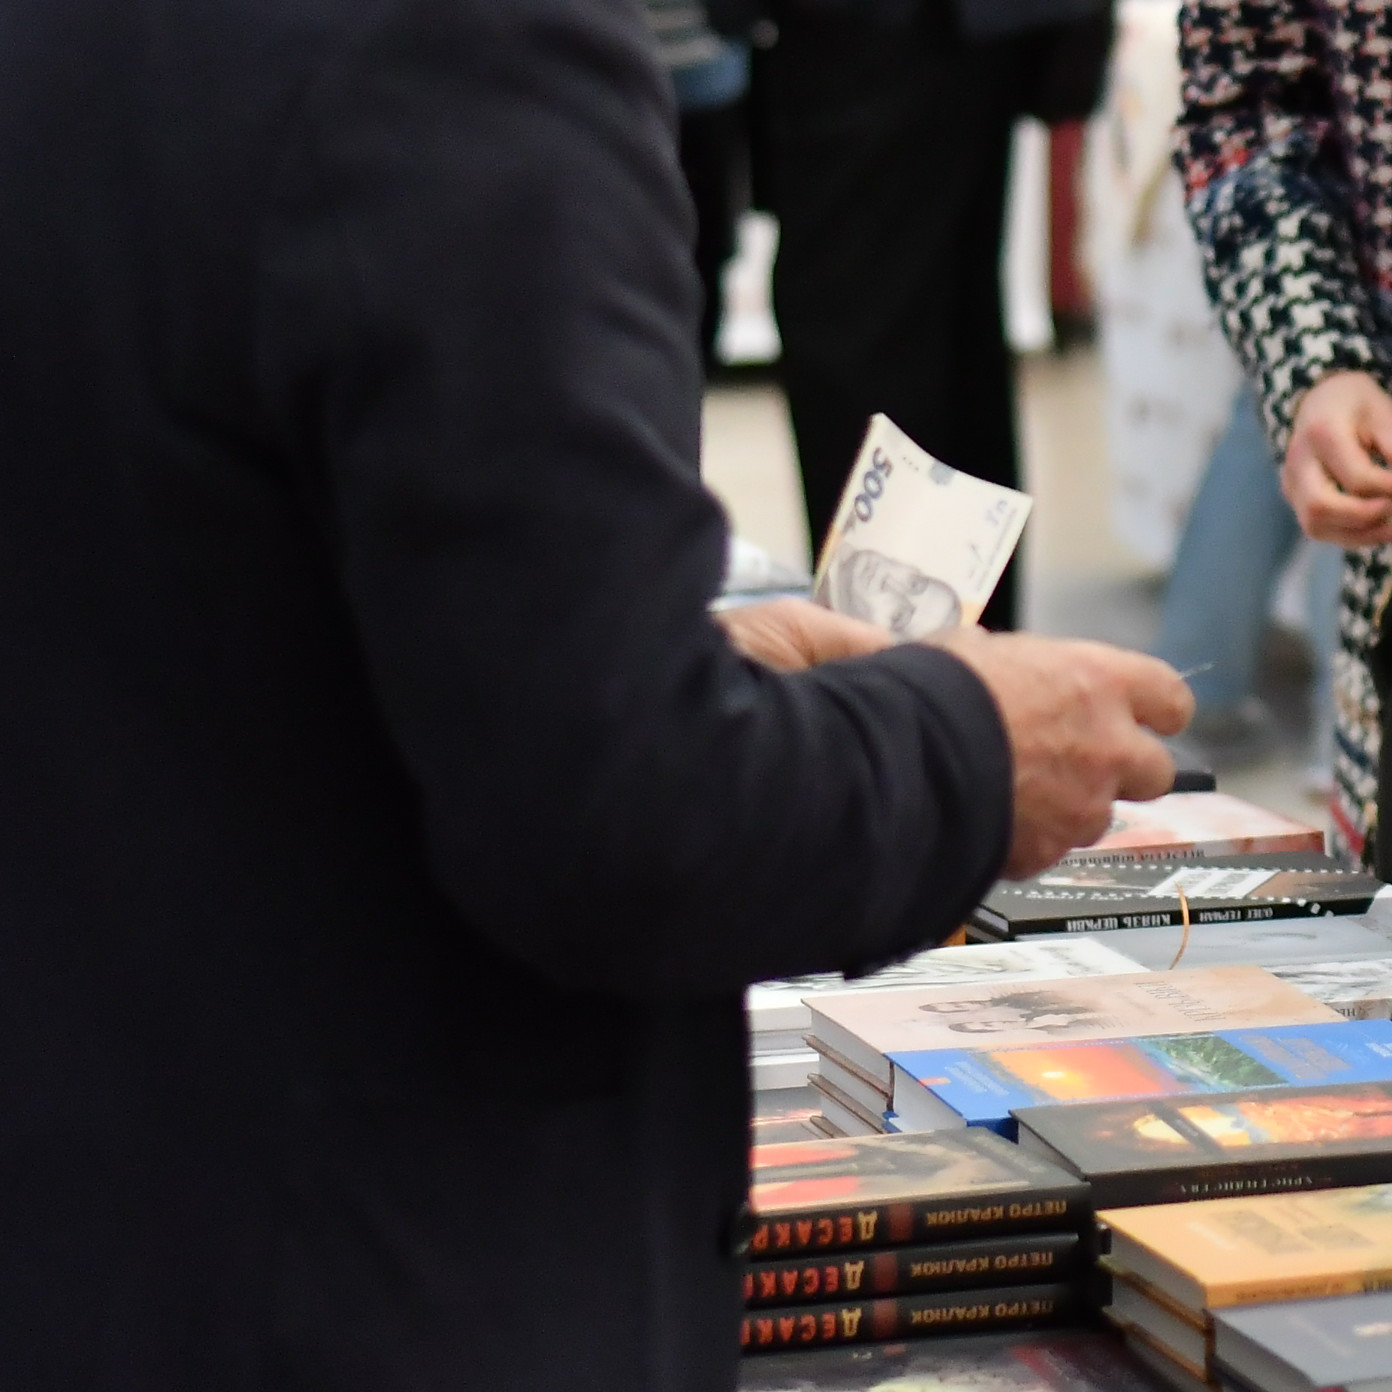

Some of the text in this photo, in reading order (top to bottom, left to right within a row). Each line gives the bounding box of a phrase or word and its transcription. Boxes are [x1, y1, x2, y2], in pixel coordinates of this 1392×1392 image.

[854, 447, 893, 522] 500
[1066, 912, 1171, 933] КНЯЗЬ ЦЕРКВИ
[1199, 909, 1242, 923] ГЕРМАН
[926, 1205, 1004, 1226] КРАЛЮК
[1010, 1199, 1067, 1219] ПЕТРО
[910, 1256, 990, 1278] КРАЛЮК
[994, 1251, 1054, 1271] ПЕТРО
[911, 1305, 990, 1325] КРАЛЮК
[995, 1298, 1054, 1318] ПЕТРО
